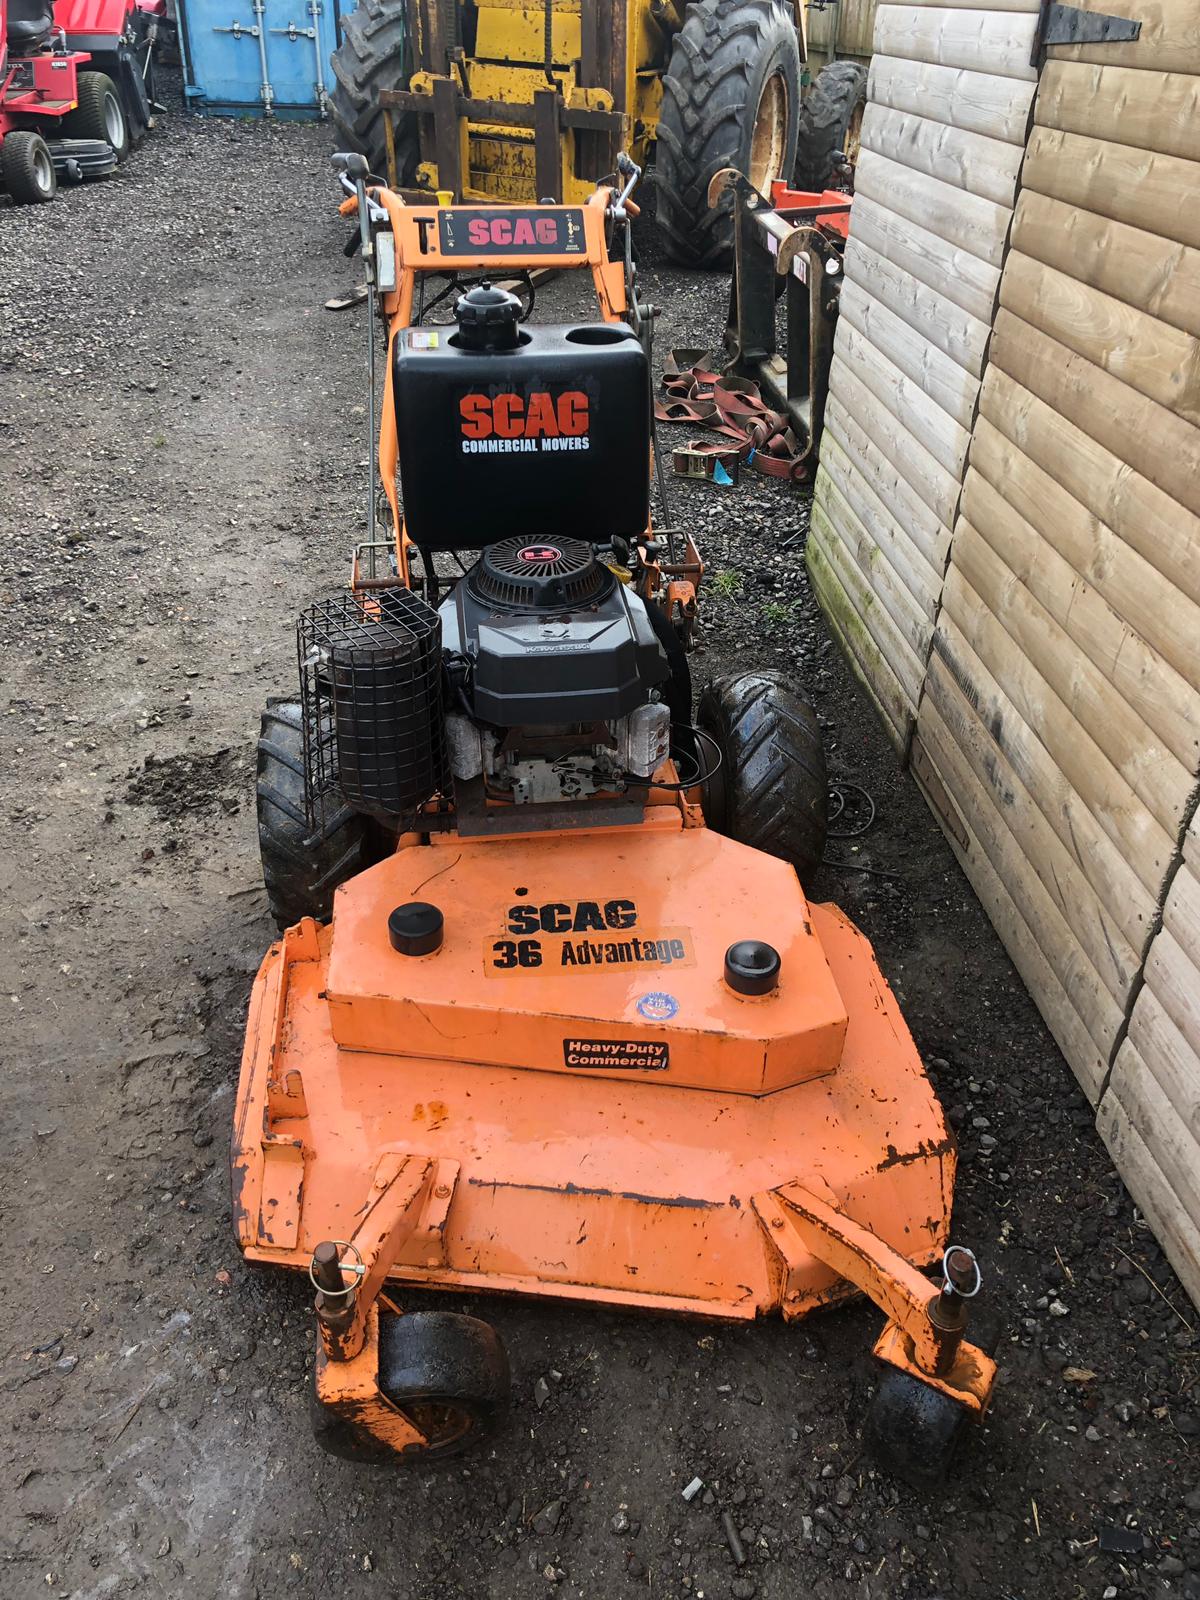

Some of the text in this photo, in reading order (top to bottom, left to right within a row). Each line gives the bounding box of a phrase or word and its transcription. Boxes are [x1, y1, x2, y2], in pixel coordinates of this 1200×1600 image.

[468, 218, 558, 246] SCAG
[460, 391, 590, 439] SCAG
[462, 437, 590, 454] COMMERCIAL MOWERS
[508, 899, 638, 935] SCAG
[492, 937, 686, 969] 36 Advantage
[567, 1053, 668, 1069] Commercial
[568, 1041, 665, 1056] Heavy-Duty
